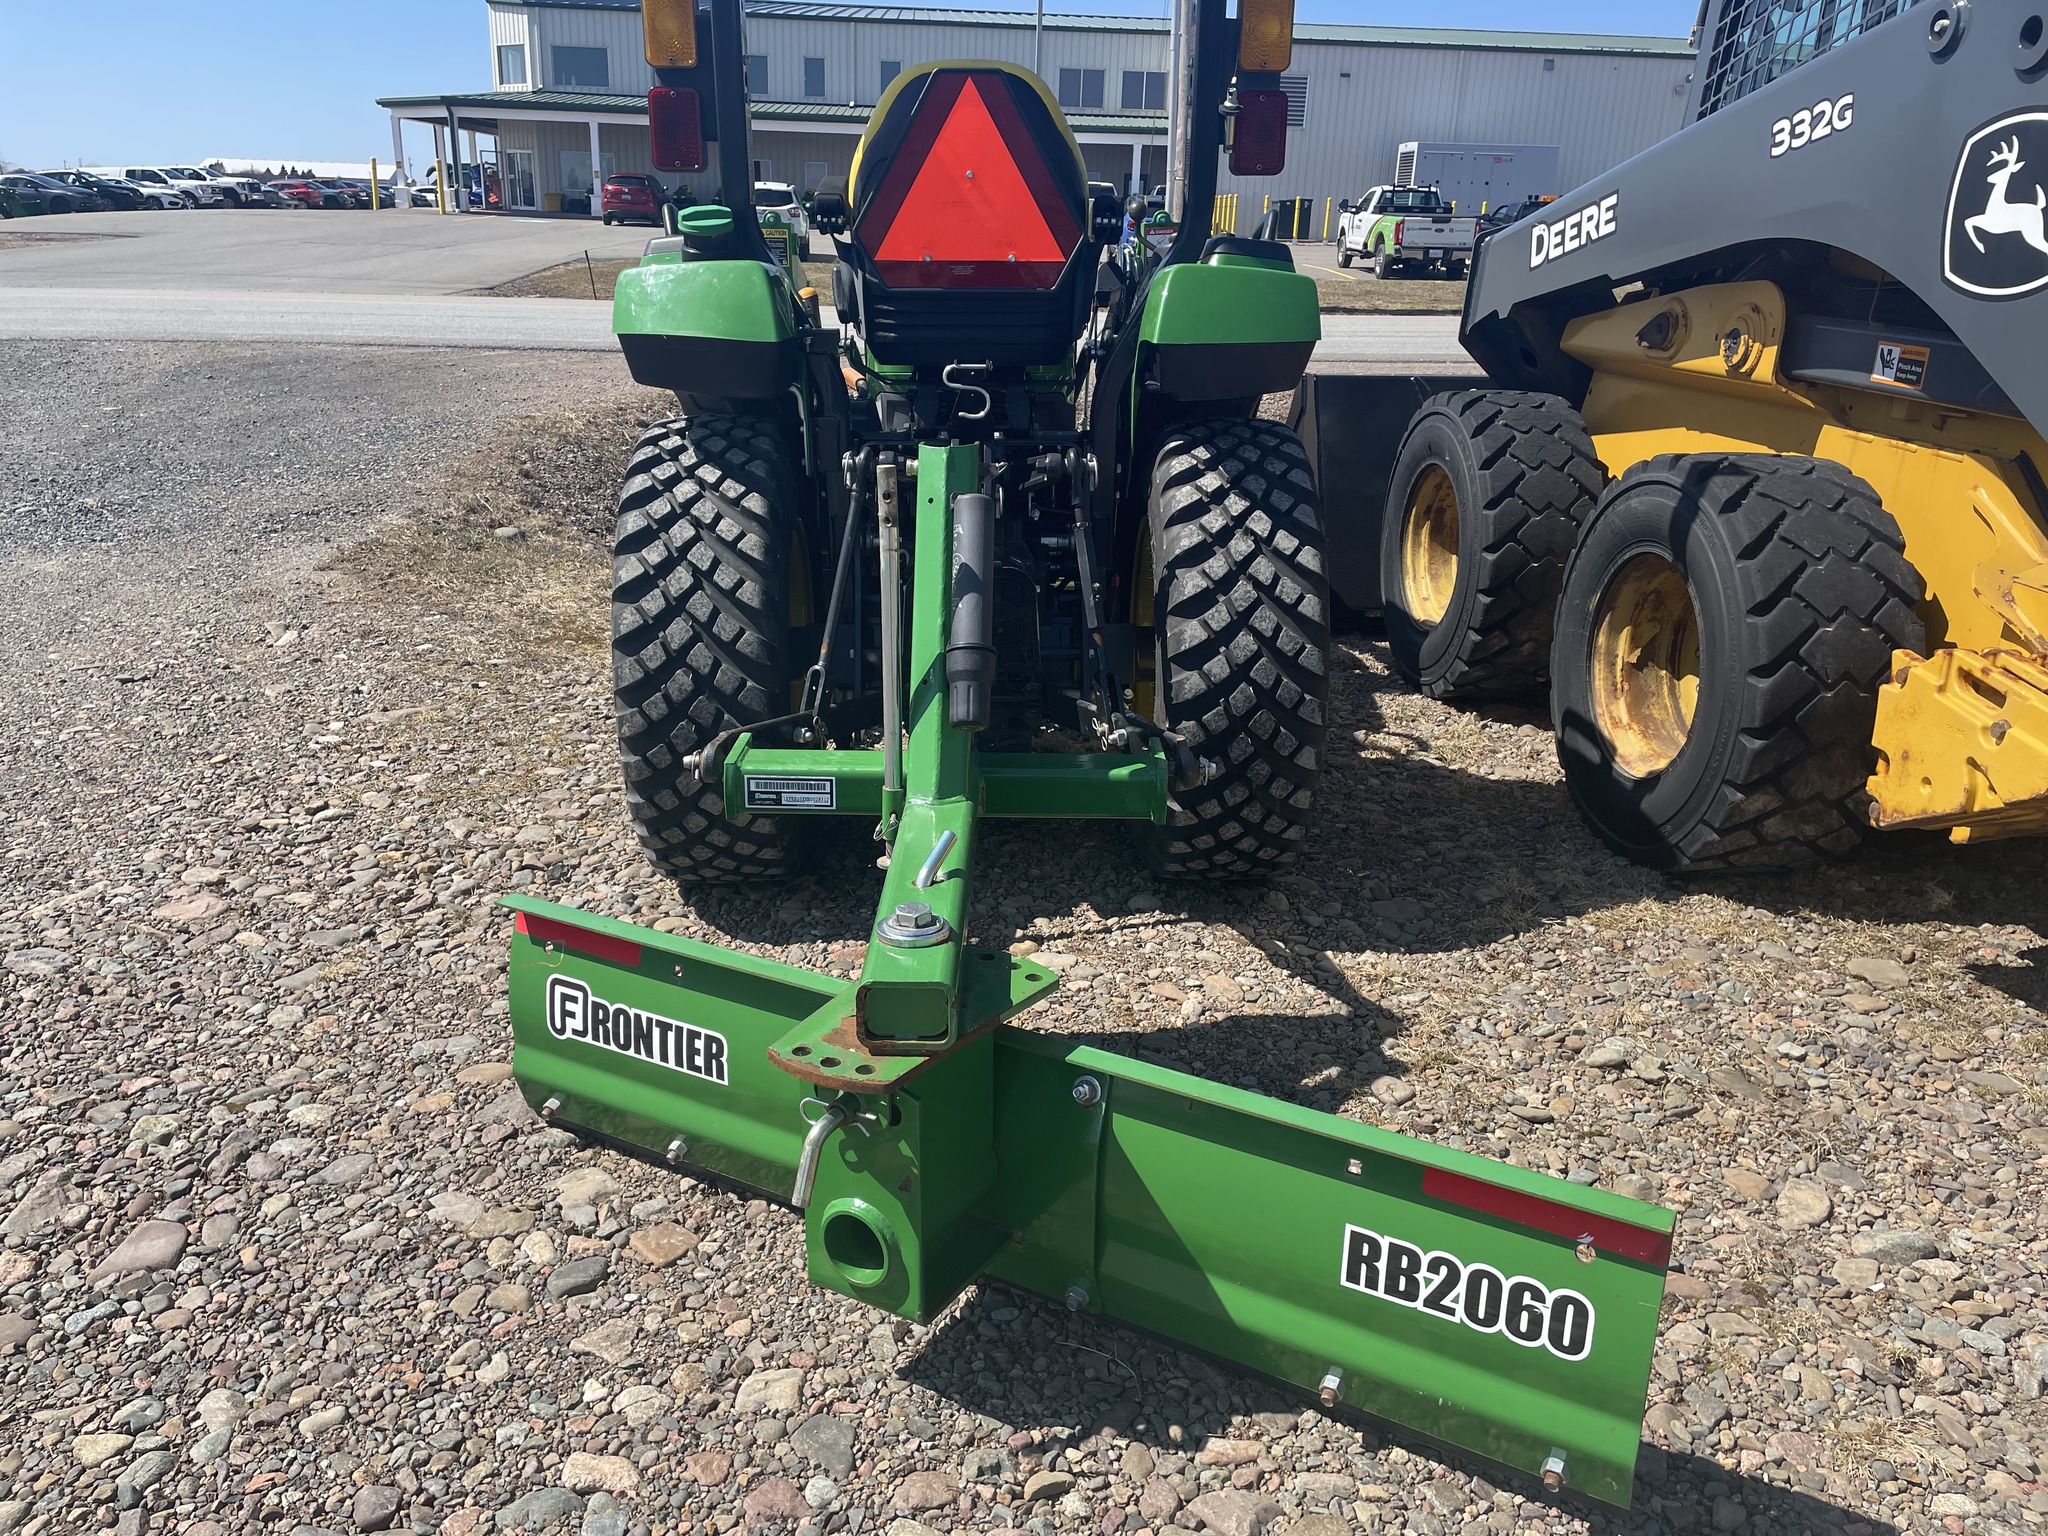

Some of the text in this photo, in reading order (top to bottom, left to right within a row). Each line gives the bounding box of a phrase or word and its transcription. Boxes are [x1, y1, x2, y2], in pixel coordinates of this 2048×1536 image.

[1770, 94, 1854, 159] 332G
[1529, 192, 1618, 270] DEERE
[1907, 373, 1917, 381] Away
[549, 976, 726, 1082] FRONTIER
[1345, 1229, 1590, 1357] RB2060
